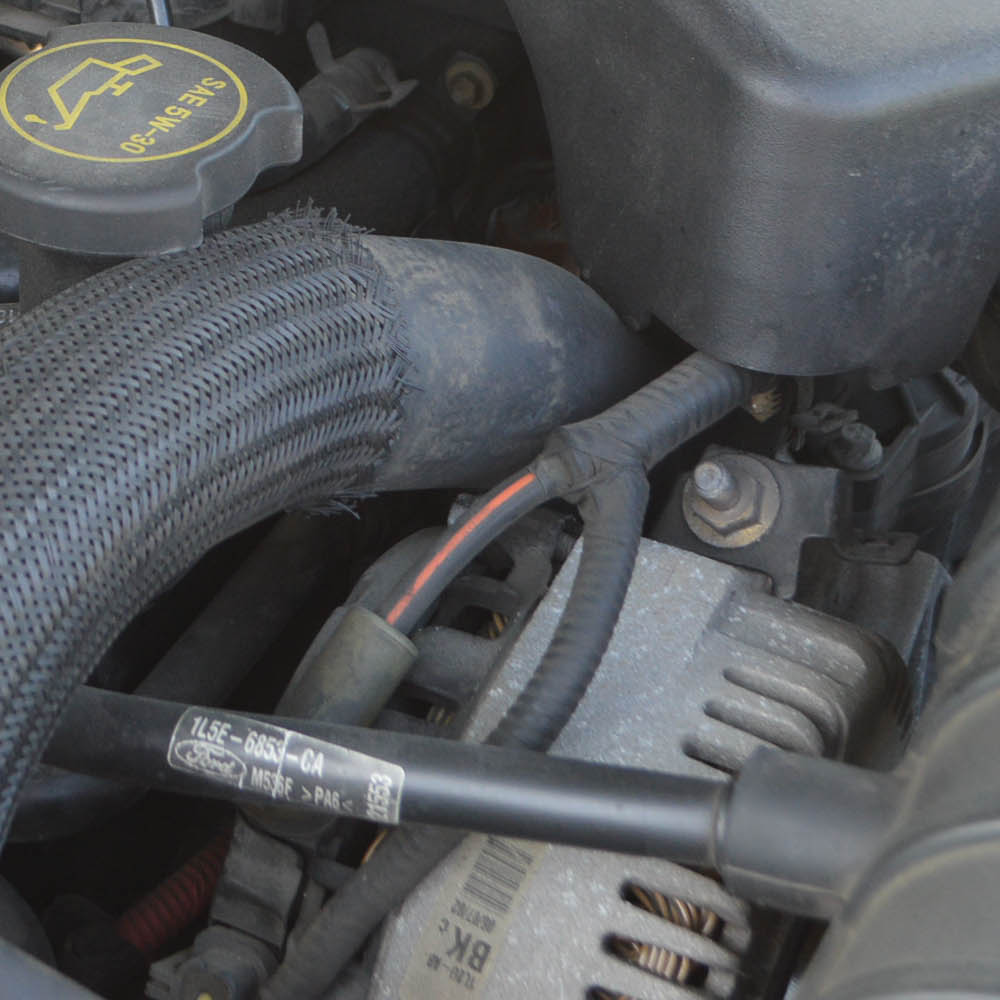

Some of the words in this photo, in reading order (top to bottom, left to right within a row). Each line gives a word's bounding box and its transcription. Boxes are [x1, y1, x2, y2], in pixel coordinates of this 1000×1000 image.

[178, 77, 227, 107] SAE
[120, 105, 193, 154] 5W-30
[186, 743, 236, 776] Ford
[446, 926, 492, 974] BK
